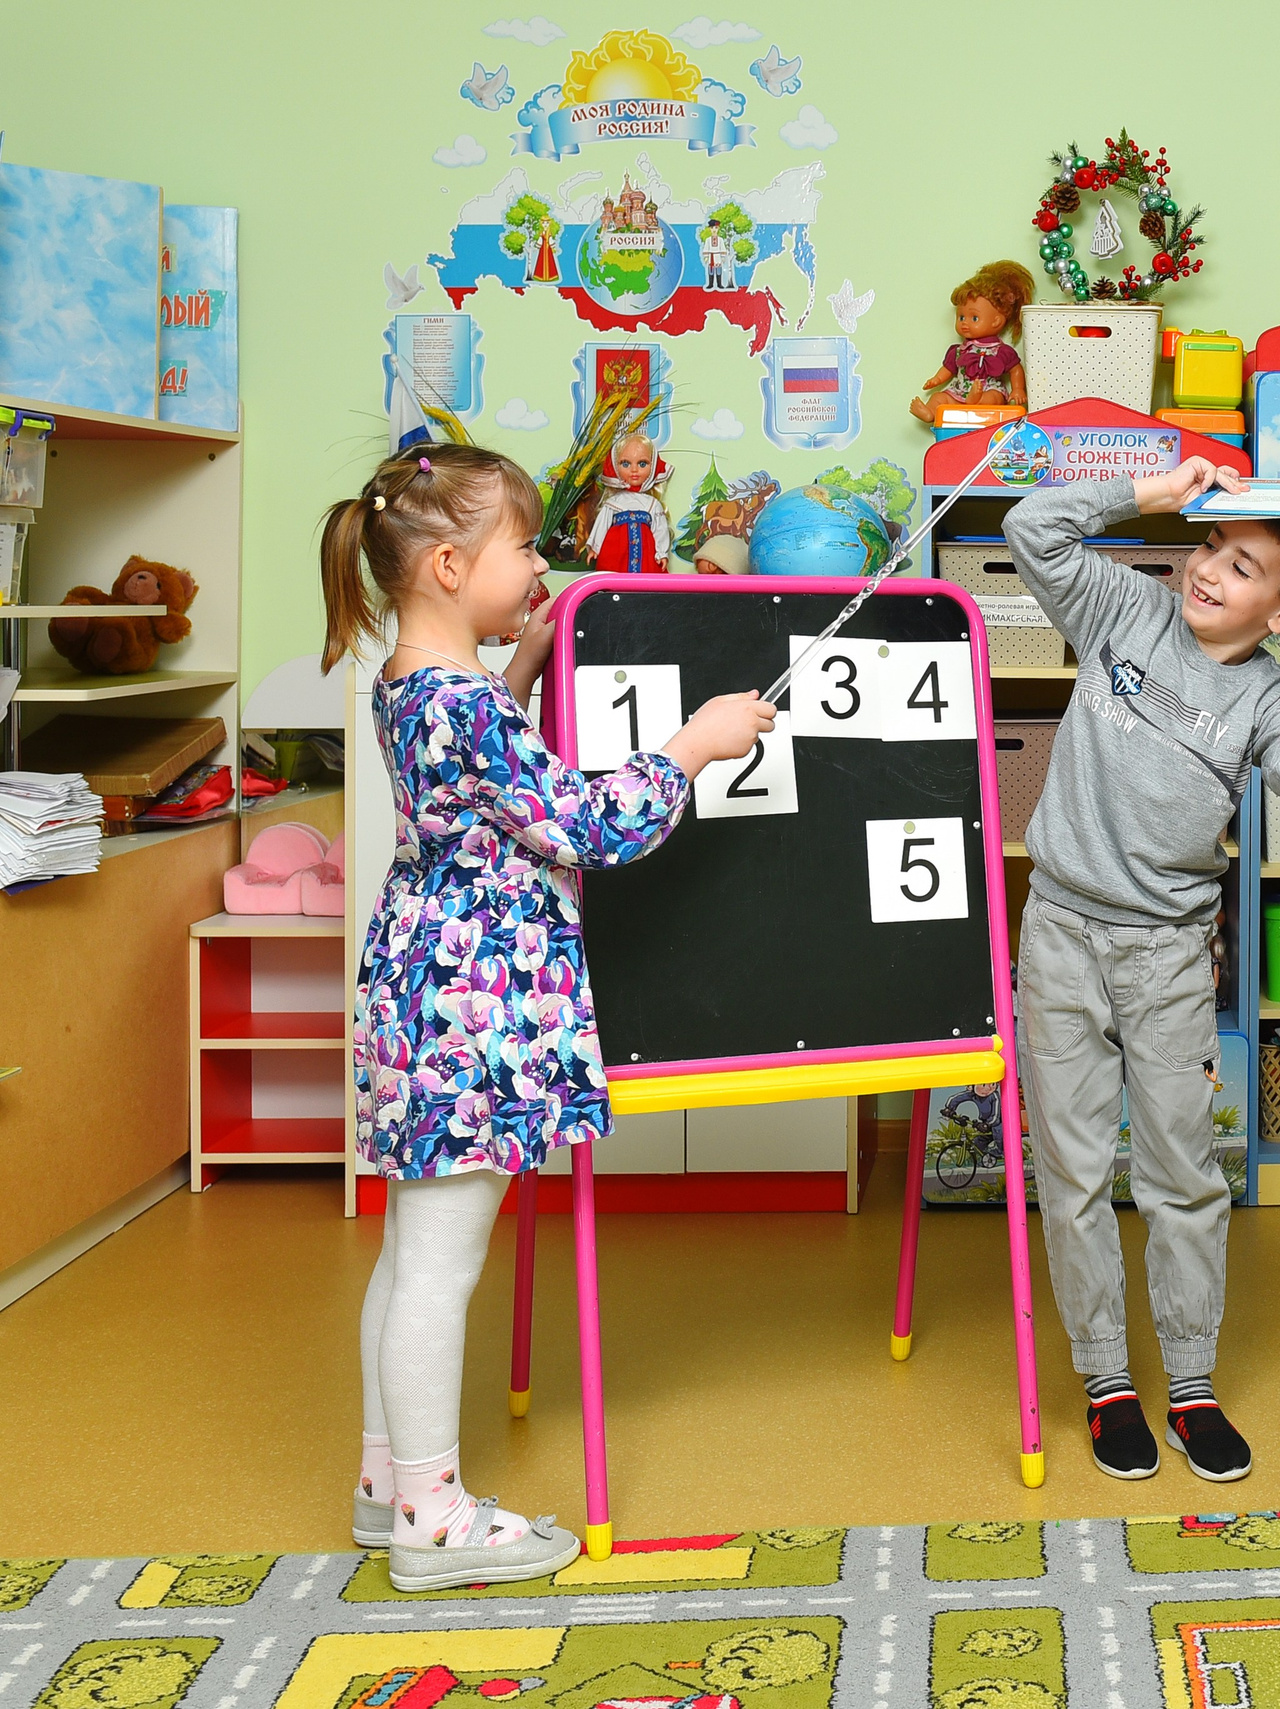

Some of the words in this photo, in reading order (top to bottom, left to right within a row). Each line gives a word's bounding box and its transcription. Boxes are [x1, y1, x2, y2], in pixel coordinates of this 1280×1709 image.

[571, 104, 610, 122] МОЯ
[616, 102, 686, 118] РОДИНА
[597, 120, 669, 136] РОССИЯ!
[610, 236, 655, 245] РОССИЯ
[787, 405, 836, 413] РОССИЙСКОЙ
[788, 414, 836, 422] ФЕДЕРАЦИИ
[1079, 432, 1148, 448] УГОЛОК
[1066, 450, 1166, 466] СЮЖЕТНО-
[820, 655, 861, 720] 3
[907, 661, 949, 723] 4
[612, 685, 639, 752] 1
[1101, 701, 1138, 734] SHOW
[1191, 710, 1230, 748] FLY
[726, 740, 769, 798] 2
[900, 837, 940, 902] 5
